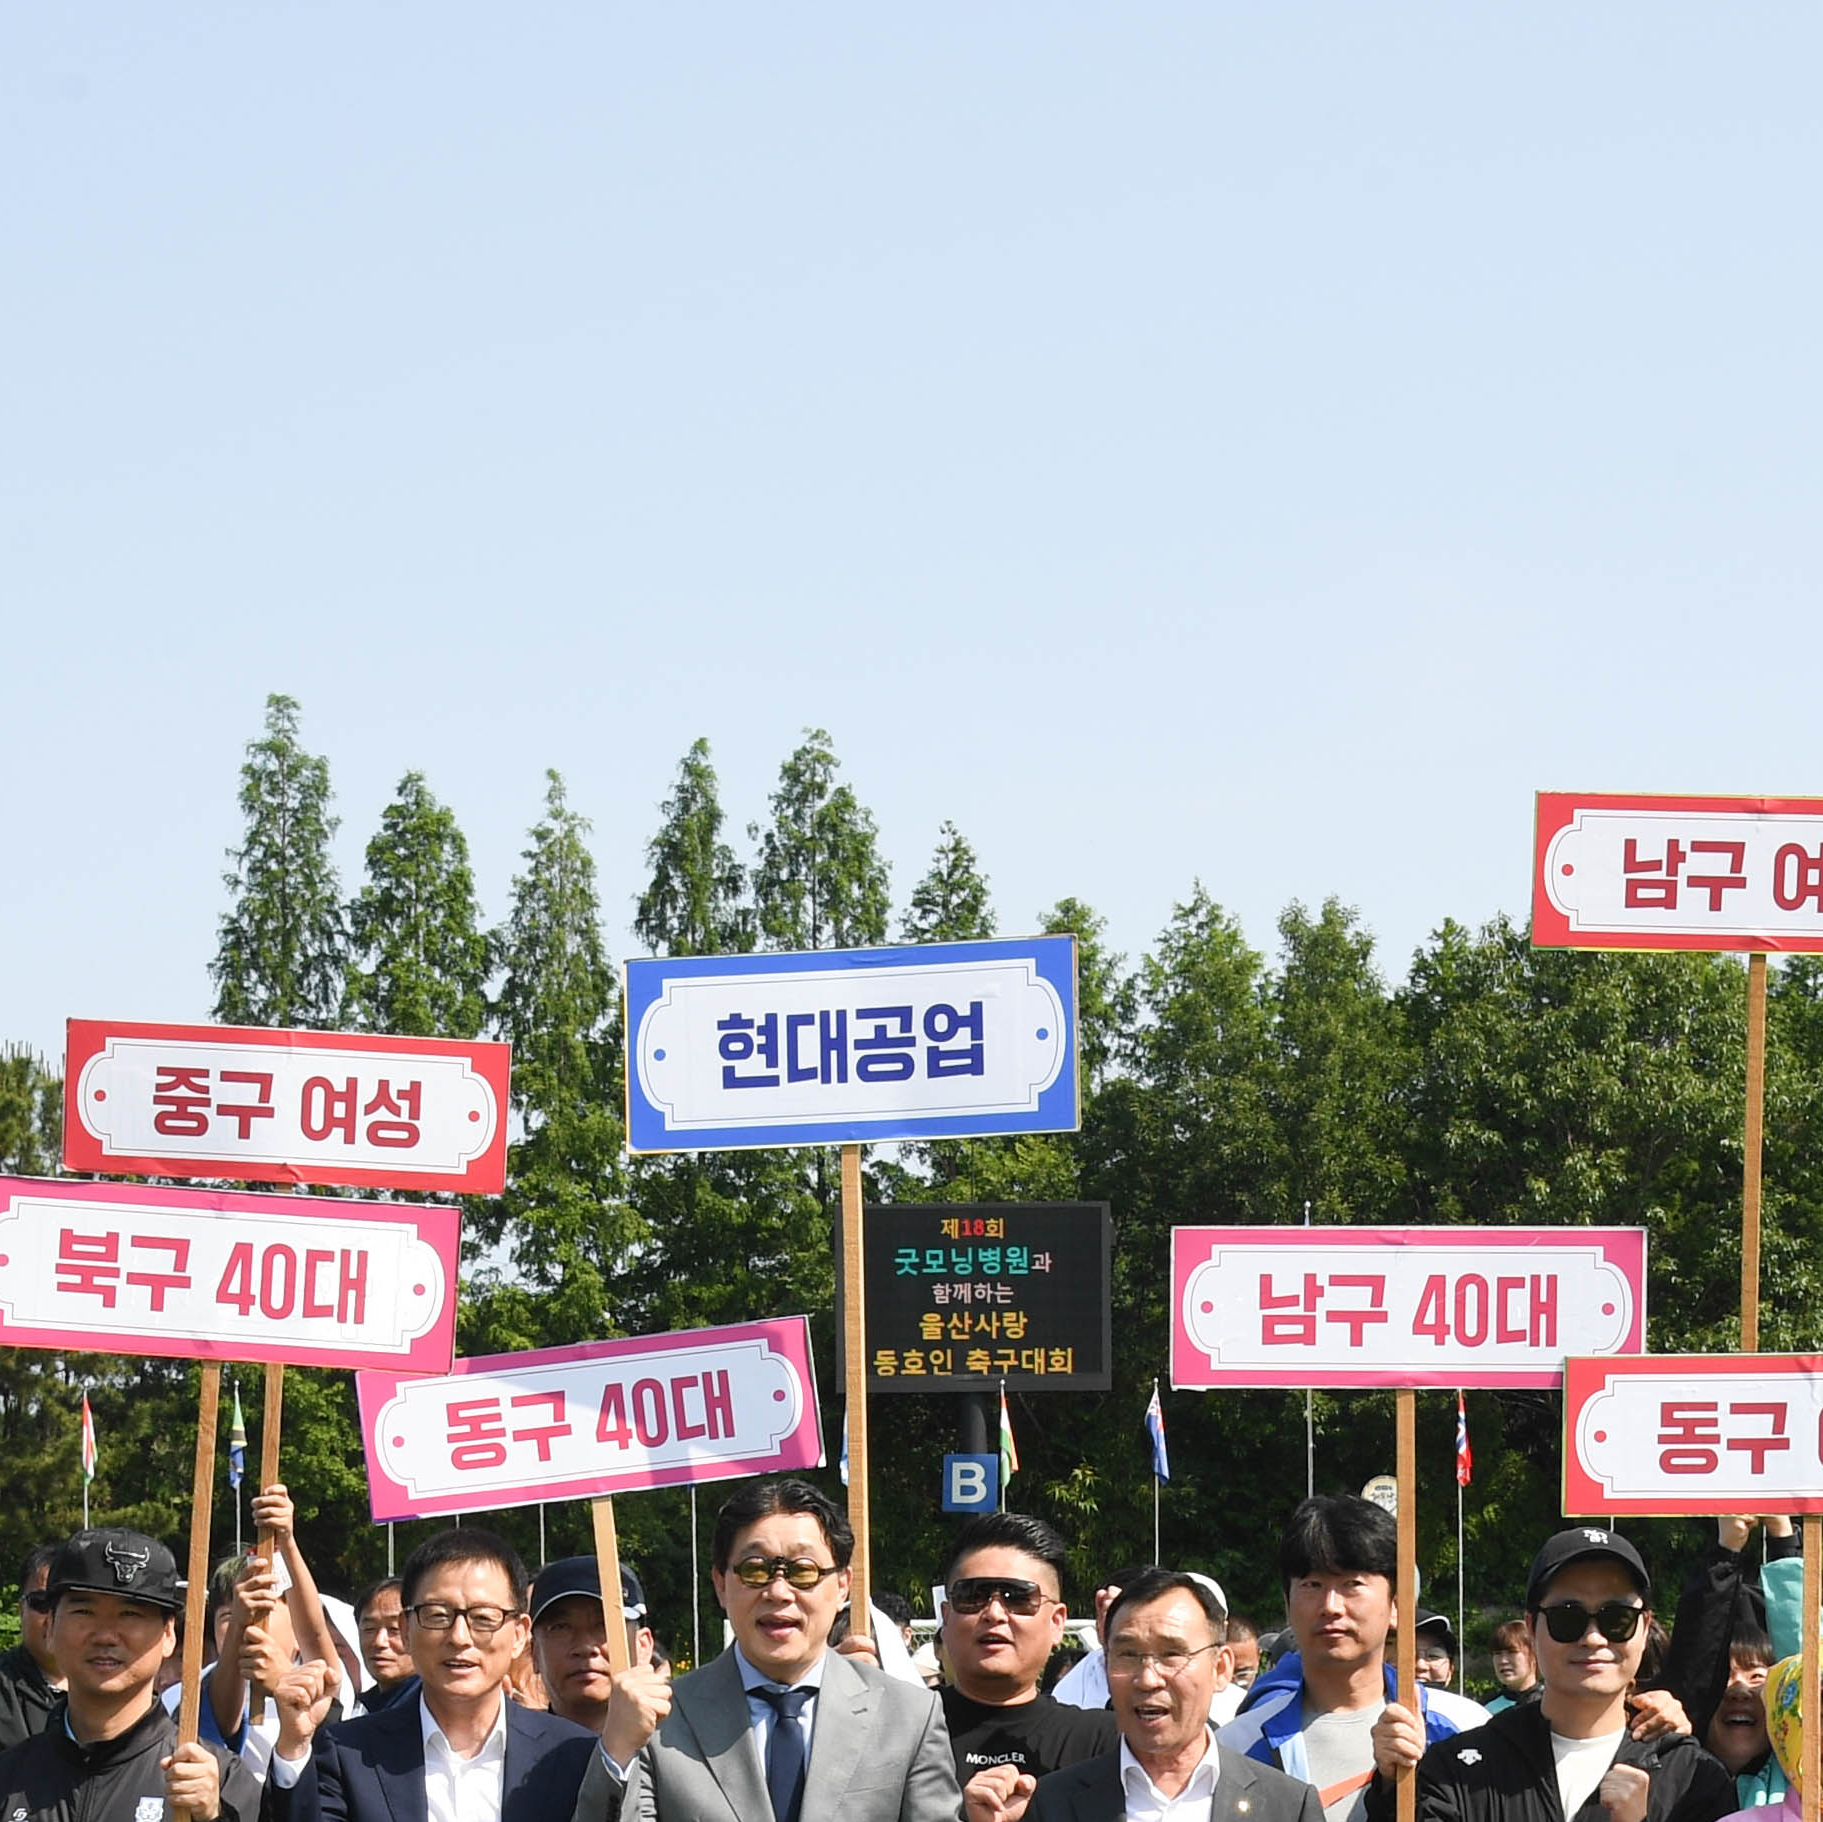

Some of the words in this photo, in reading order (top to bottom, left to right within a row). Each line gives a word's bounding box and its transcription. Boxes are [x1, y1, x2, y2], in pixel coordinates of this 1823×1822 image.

[1626, 840, 1745, 909] 남구
[721, 1005, 980, 1086] 현대공업
[157, 1070, 272, 1137] 중구
[303, 1078, 420, 1146] 여성
[941, 1218, 1005, 1239] 제18회
[57, 1230, 190, 1310] 북구
[217, 1243, 366, 1322] 40대
[932, 1282, 1014, 1304] 함께하는
[1261, 1275, 1387, 1346] 남구
[1414, 1275, 1556, 1346] 40대
[919, 1311, 1027, 1340] 울산사랑
[873, 1349, 953, 1376] 동호인
[965, 1347, 1074, 1376] 축구대회
[448, 1394, 571, 1469] 동구
[597, 1373, 732, 1448] 40대
[1660, 1404, 1788, 1473] 동구
[951, 1461, 986, 1504] B
[966, 1751, 1026, 1765] MONCLER
